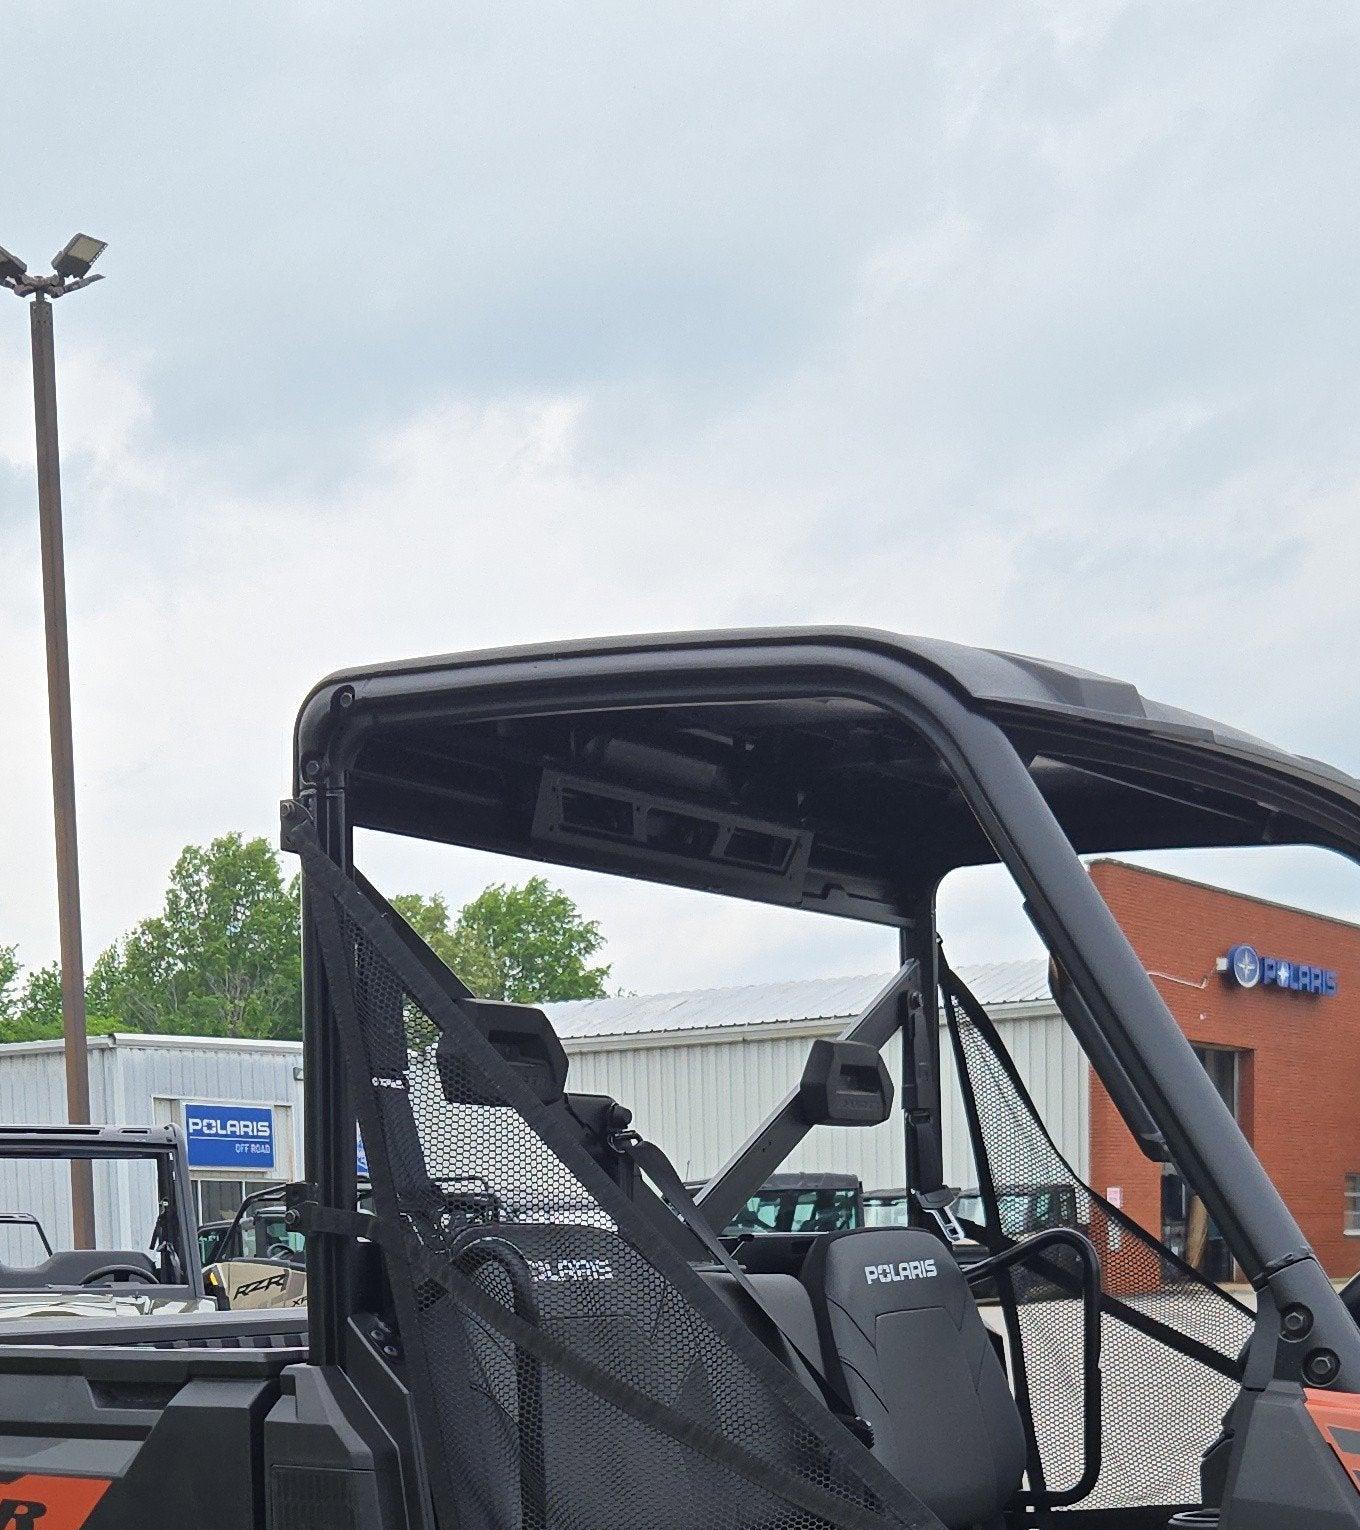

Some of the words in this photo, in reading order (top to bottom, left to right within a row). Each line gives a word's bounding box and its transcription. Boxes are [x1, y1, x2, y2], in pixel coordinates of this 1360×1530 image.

[1260, 955, 1337, 997] POLARIS
[188, 1118, 270, 1136] POLARIS
[235, 1143, 249, 1154] OFF
[251, 1144, 271, 1154] ROAD
[864, 1259, 938, 1284] POLARIS
[233, 1269, 290, 1301] RZR
